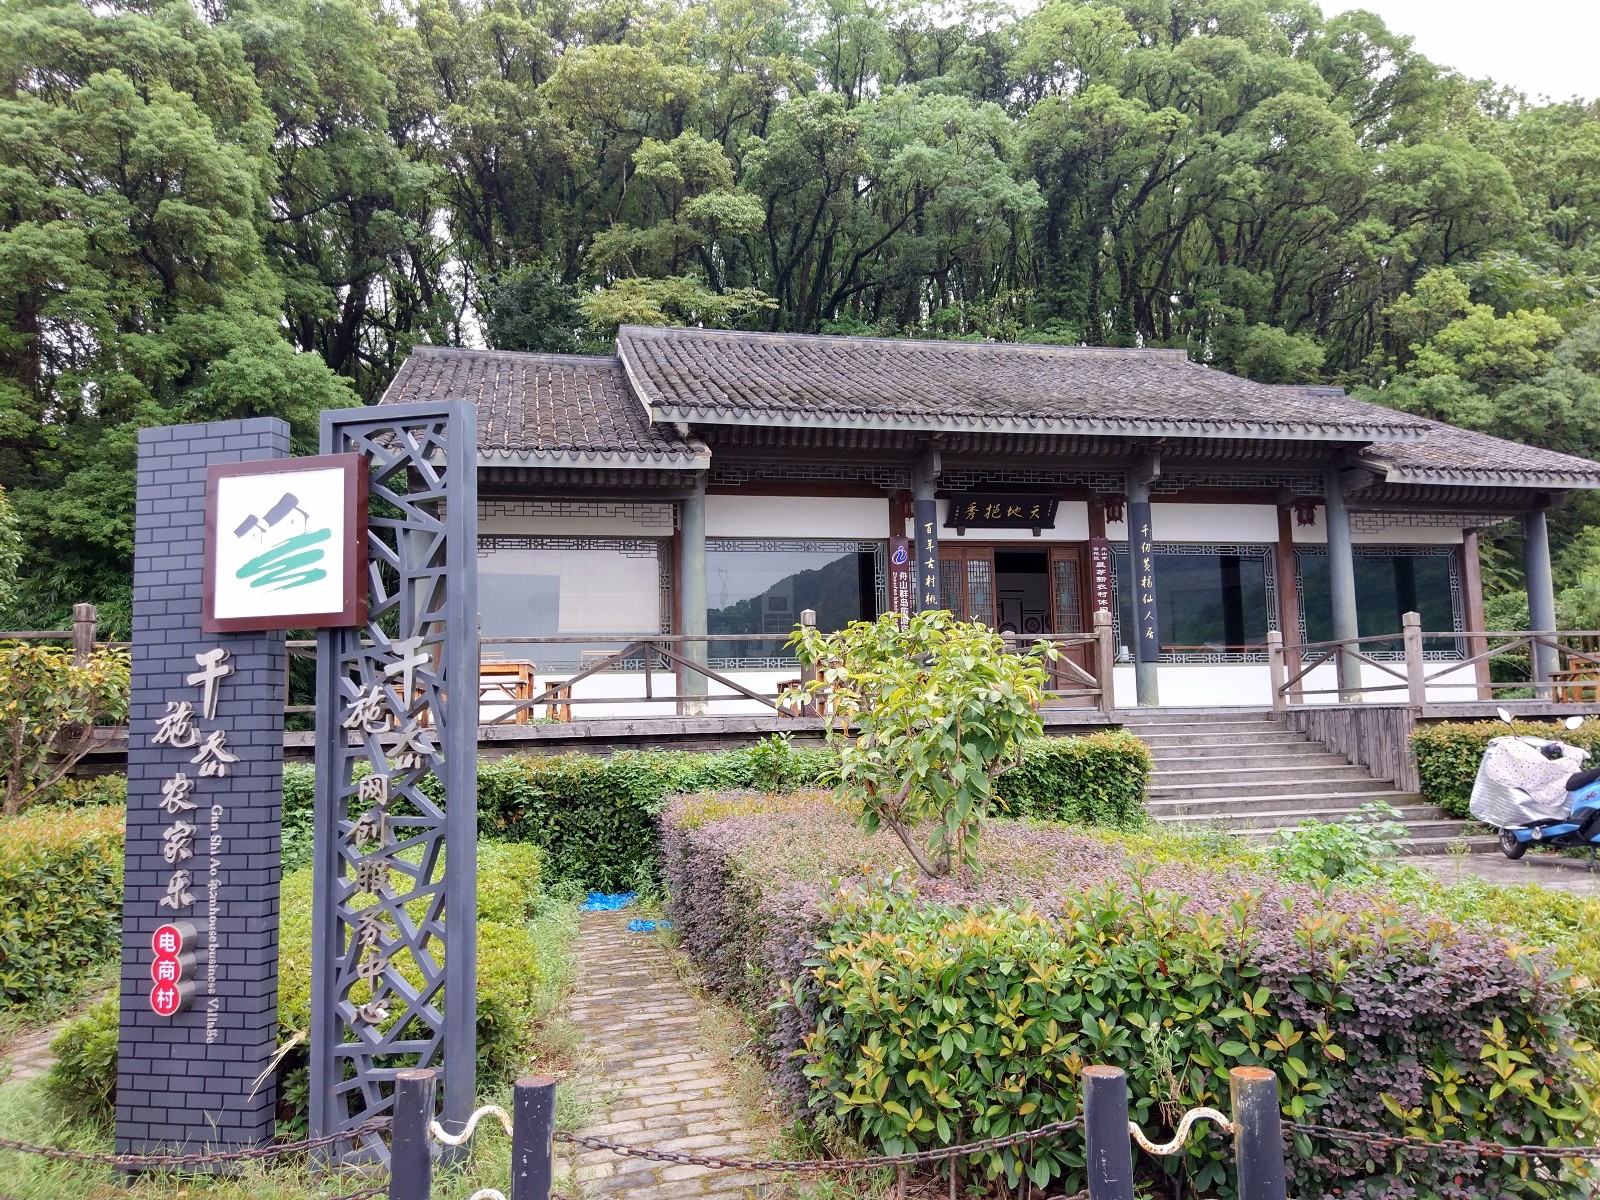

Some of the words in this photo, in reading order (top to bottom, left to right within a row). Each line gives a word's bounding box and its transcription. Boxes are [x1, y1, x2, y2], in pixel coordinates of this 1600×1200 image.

[211, 804, 224, 831] Gan
[210, 834, 222, 855] Shi
[209, 857, 221, 877] Ao
[157, 931, 177, 1010] 电商村
[207, 943, 220, 995] business
[206, 997, 219, 1044] Village
